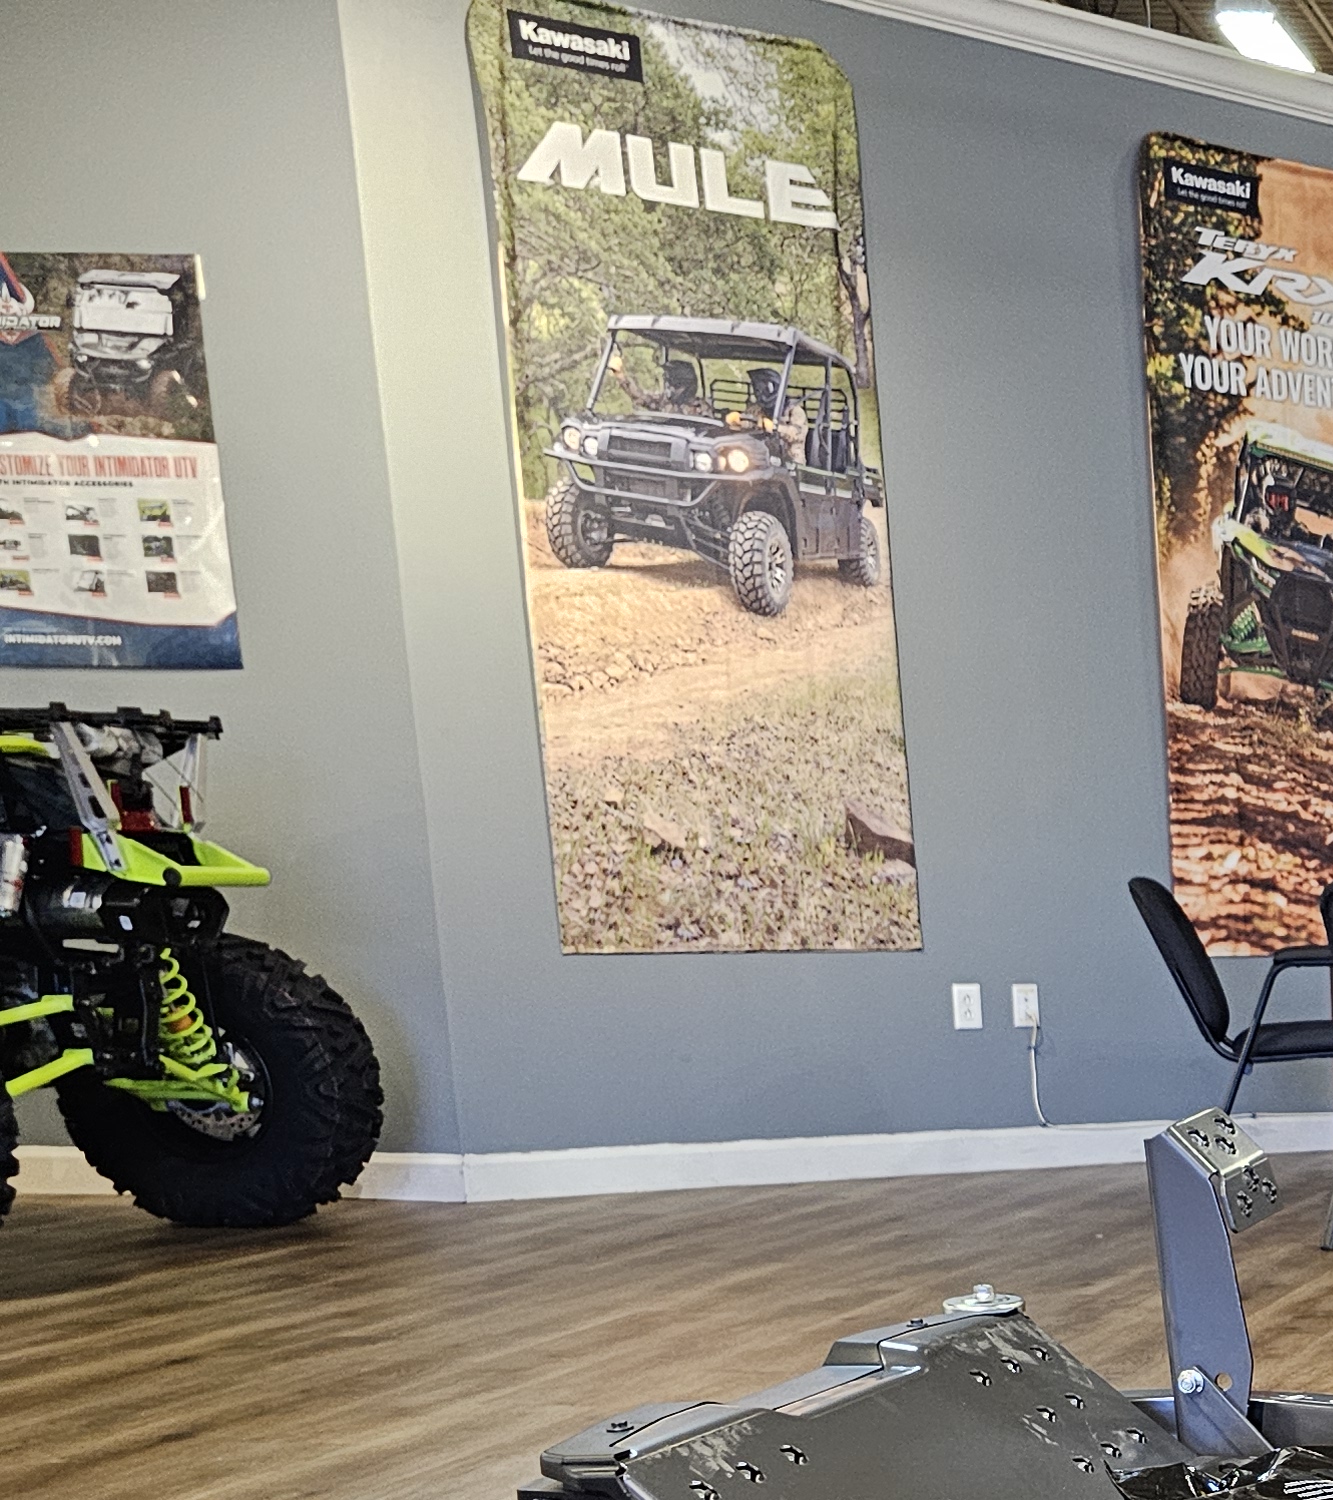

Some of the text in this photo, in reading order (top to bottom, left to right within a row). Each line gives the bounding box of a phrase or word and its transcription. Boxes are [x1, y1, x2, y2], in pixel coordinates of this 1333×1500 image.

[518, 19, 630, 61] Kawasaki
[517, 121, 840, 231] MULE
[1171, 166, 1251, 199] Kawasaki
[1204, 315, 1272, 360] YOUR
[1179, 352, 1247, 396] YOUR
[59, 454, 91, 478] YOUR
[94, 455, 170, 478] INTIMIDATOR
[174, 456, 197, 478] UTV
